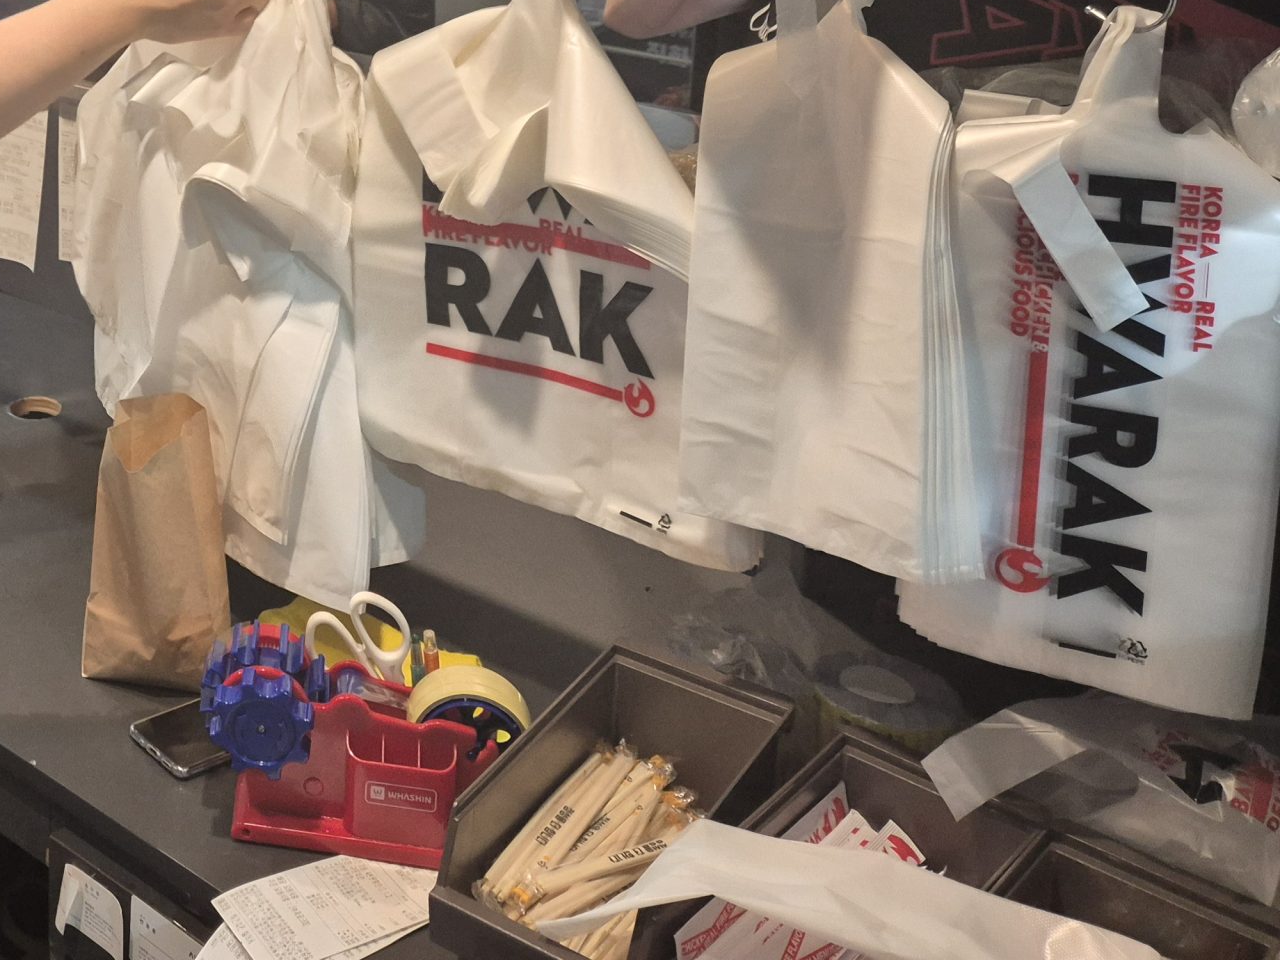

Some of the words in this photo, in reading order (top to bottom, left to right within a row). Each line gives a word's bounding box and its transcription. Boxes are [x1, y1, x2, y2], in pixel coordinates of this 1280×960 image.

[1178, 183, 1202, 229] FIRE
[1200, 185, 1223, 259] KOREA
[1172, 232, 1197, 314] FLAVOR
[424, 242, 656, 380] RAK
[1193, 300, 1216, 353] REAL
[387, 790, 432, 805] WHASHIN
